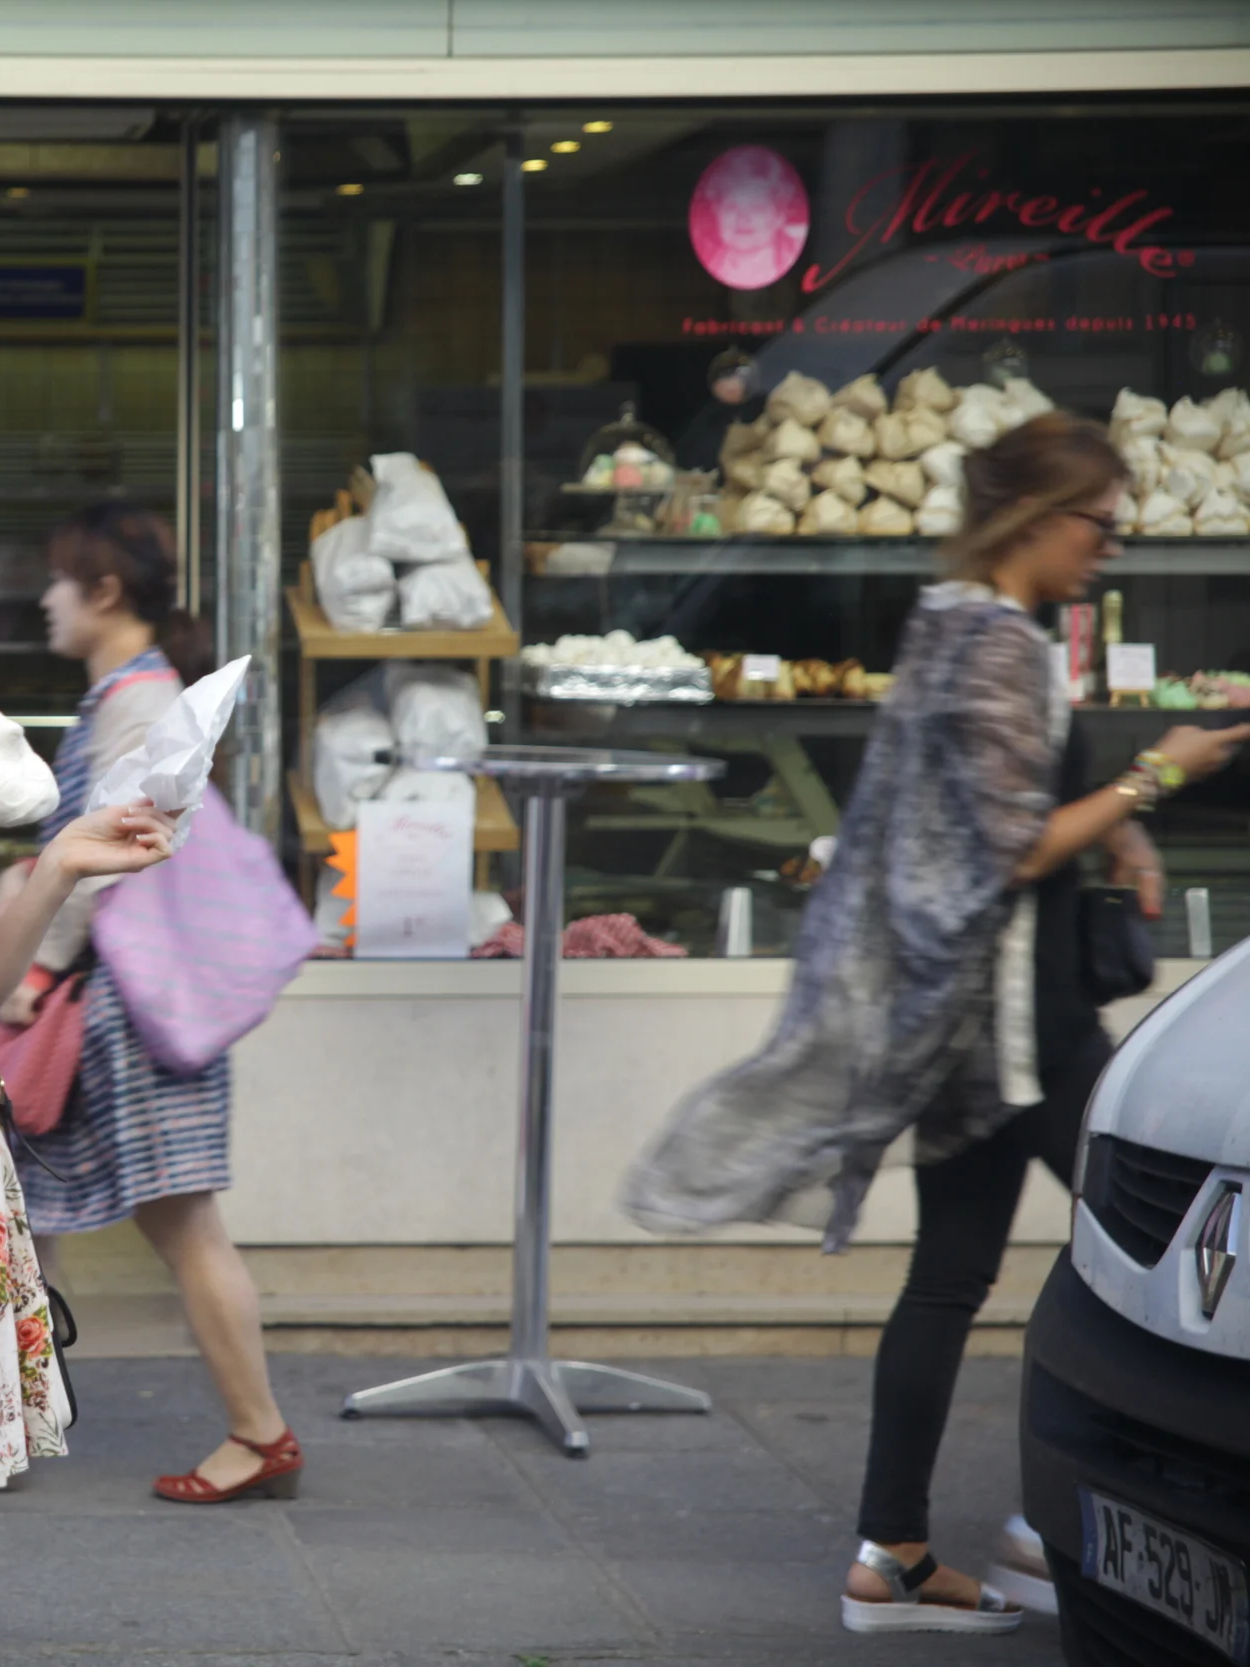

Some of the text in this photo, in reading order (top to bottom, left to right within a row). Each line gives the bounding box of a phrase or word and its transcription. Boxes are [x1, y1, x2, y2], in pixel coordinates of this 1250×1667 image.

[801, 148, 1178, 293] Mireille
[681, 316, 785, 335] Fabricant
[915, 315, 943, 334] de
[950, 316, 1056, 334] Meringues
[1064, 315, 1134, 333] depuis
[1145, 312, 1197, 331] 1945
